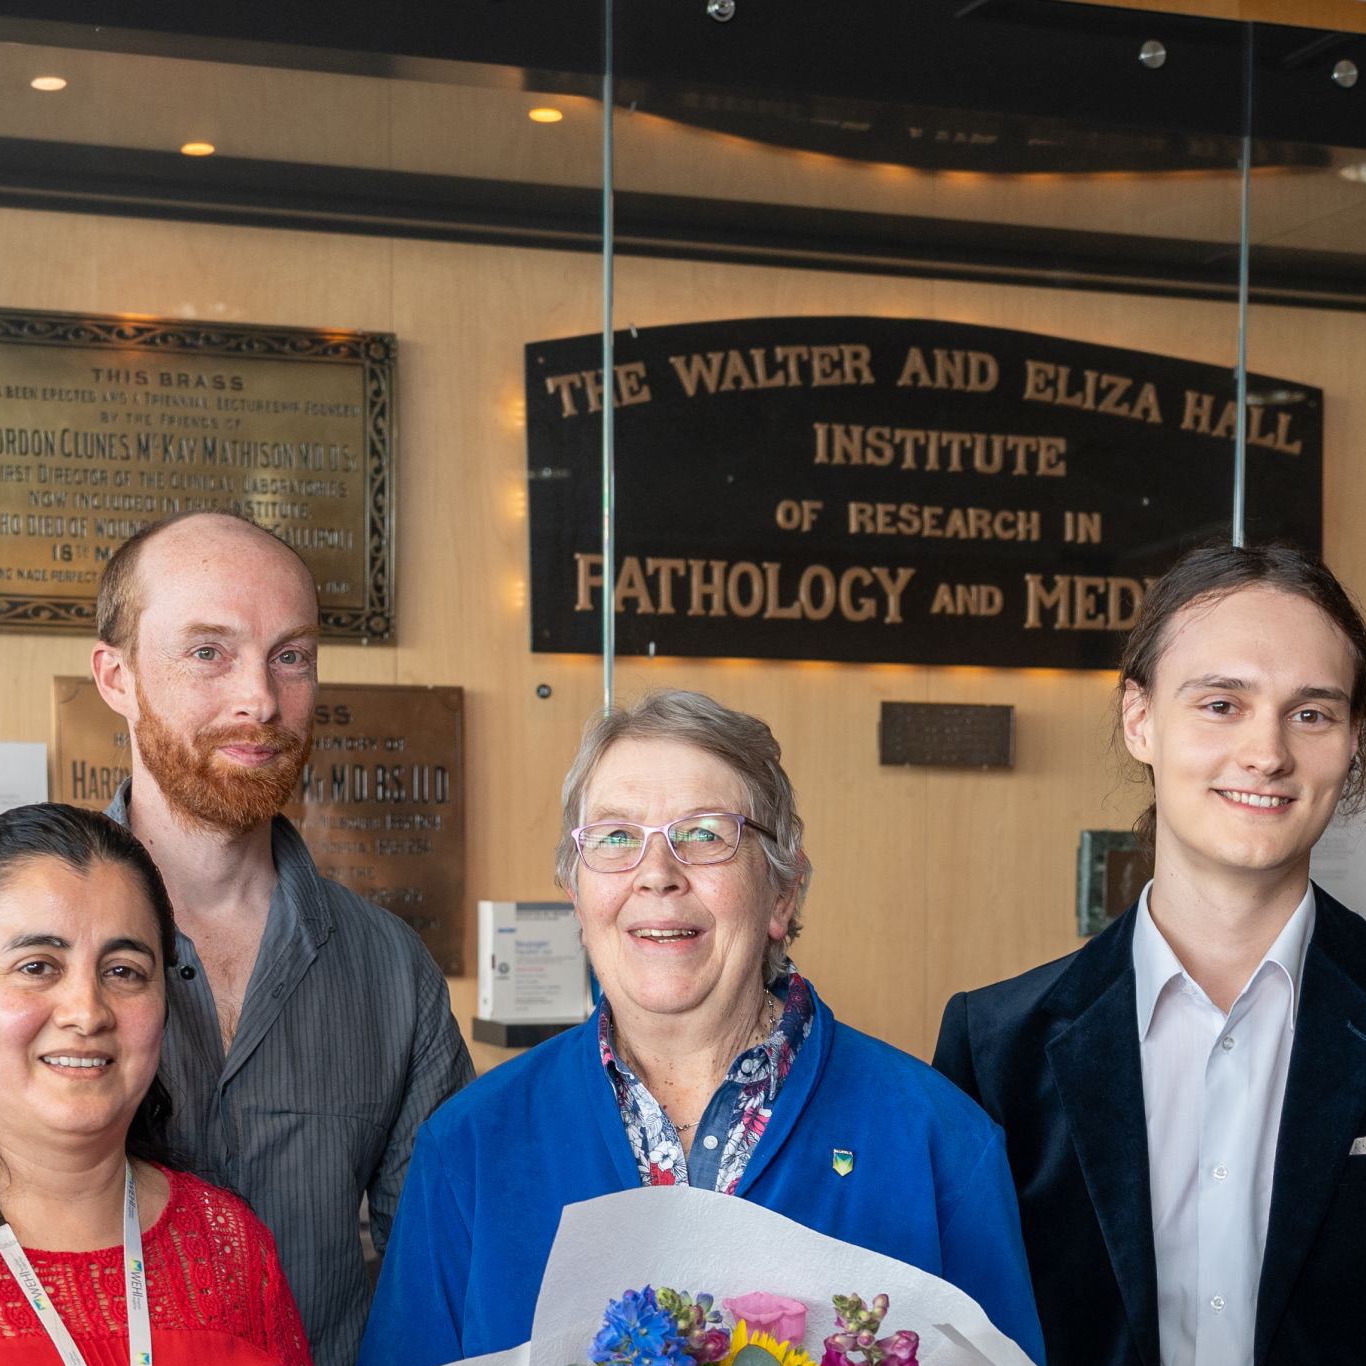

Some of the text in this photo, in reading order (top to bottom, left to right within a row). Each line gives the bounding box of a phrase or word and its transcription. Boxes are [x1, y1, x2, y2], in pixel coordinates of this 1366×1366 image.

[91, 368, 244, 391] THIS BRASS
[545, 344, 1302, 455] THE WALTER AND ELIZA HALL
[127, 412, 153, 426] THE
[160, 413, 219, 429] FRIENDS
[60, 427, 132, 461] CLUNES
[202, 436, 296, 469] MATHISON
[813, 422, 1067, 477] INSTITUTE
[37, 464, 108, 487] DIRECTOR
[114, 470, 132, 487] OF
[139, 471, 165, 490] THE
[28, 490, 68, 508] NOW
[27, 513, 65, 537] DIED
[69, 516, 88, 538] OF
[775, 500, 1102, 544] OF RESEARCH IN
[574, 553, 1155, 631] PATHOLOGY AND MED
[18, 1269, 43, 1299] WEHI
[130, 1271, 143, 1298] WEHI
